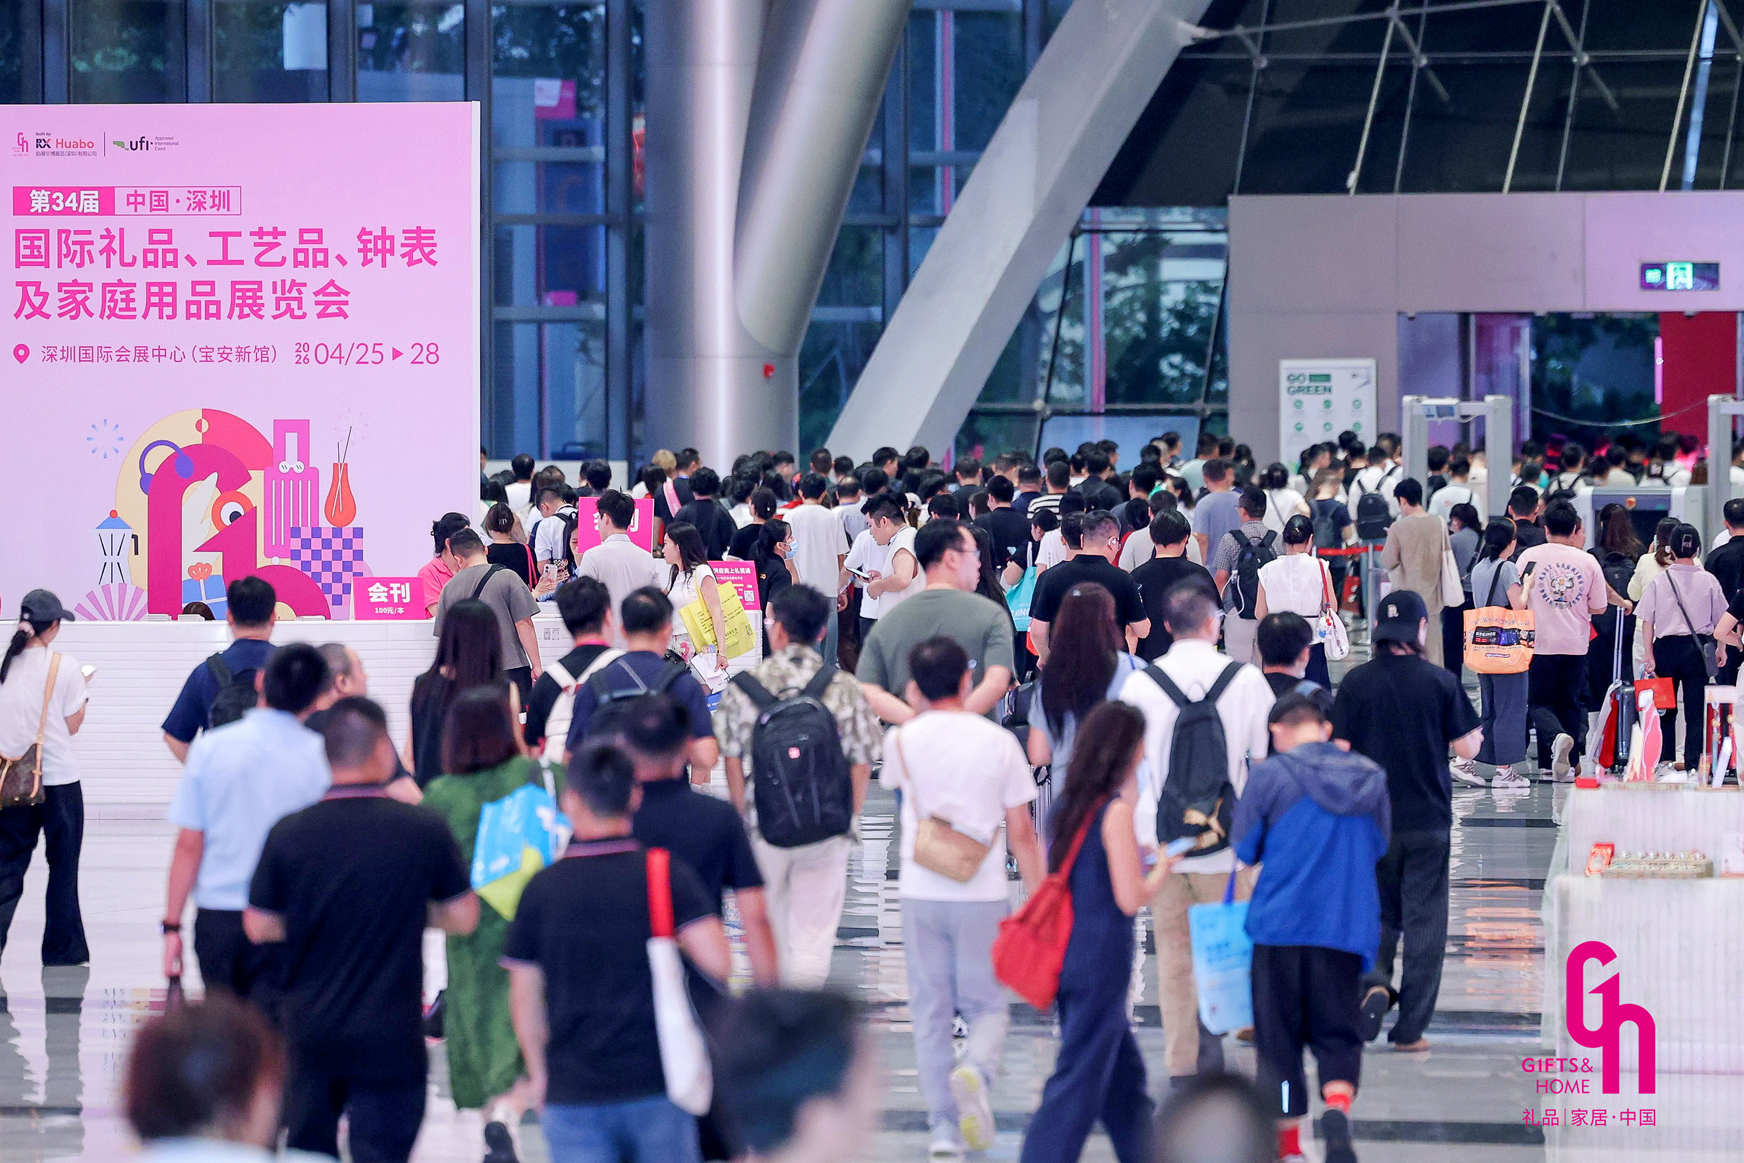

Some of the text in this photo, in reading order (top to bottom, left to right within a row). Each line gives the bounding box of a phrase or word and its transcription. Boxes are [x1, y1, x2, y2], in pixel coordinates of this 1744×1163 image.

[35, 138, 95, 149] RX Huabo
[29, 189, 100, 213] 第34届
[14, 226, 438, 268] 国际礼品、工艺品、钟表
[14, 279, 350, 320] 及家庭用品展览会
[314, 342, 384, 366] 04/25
[410, 342, 440, 365] 28
[1286, 373, 1306, 384] GO
[1286, 385, 1332, 395] GREEN
[367, 582, 411, 603] 会刊
[374, 606, 405, 615] 100元/本
